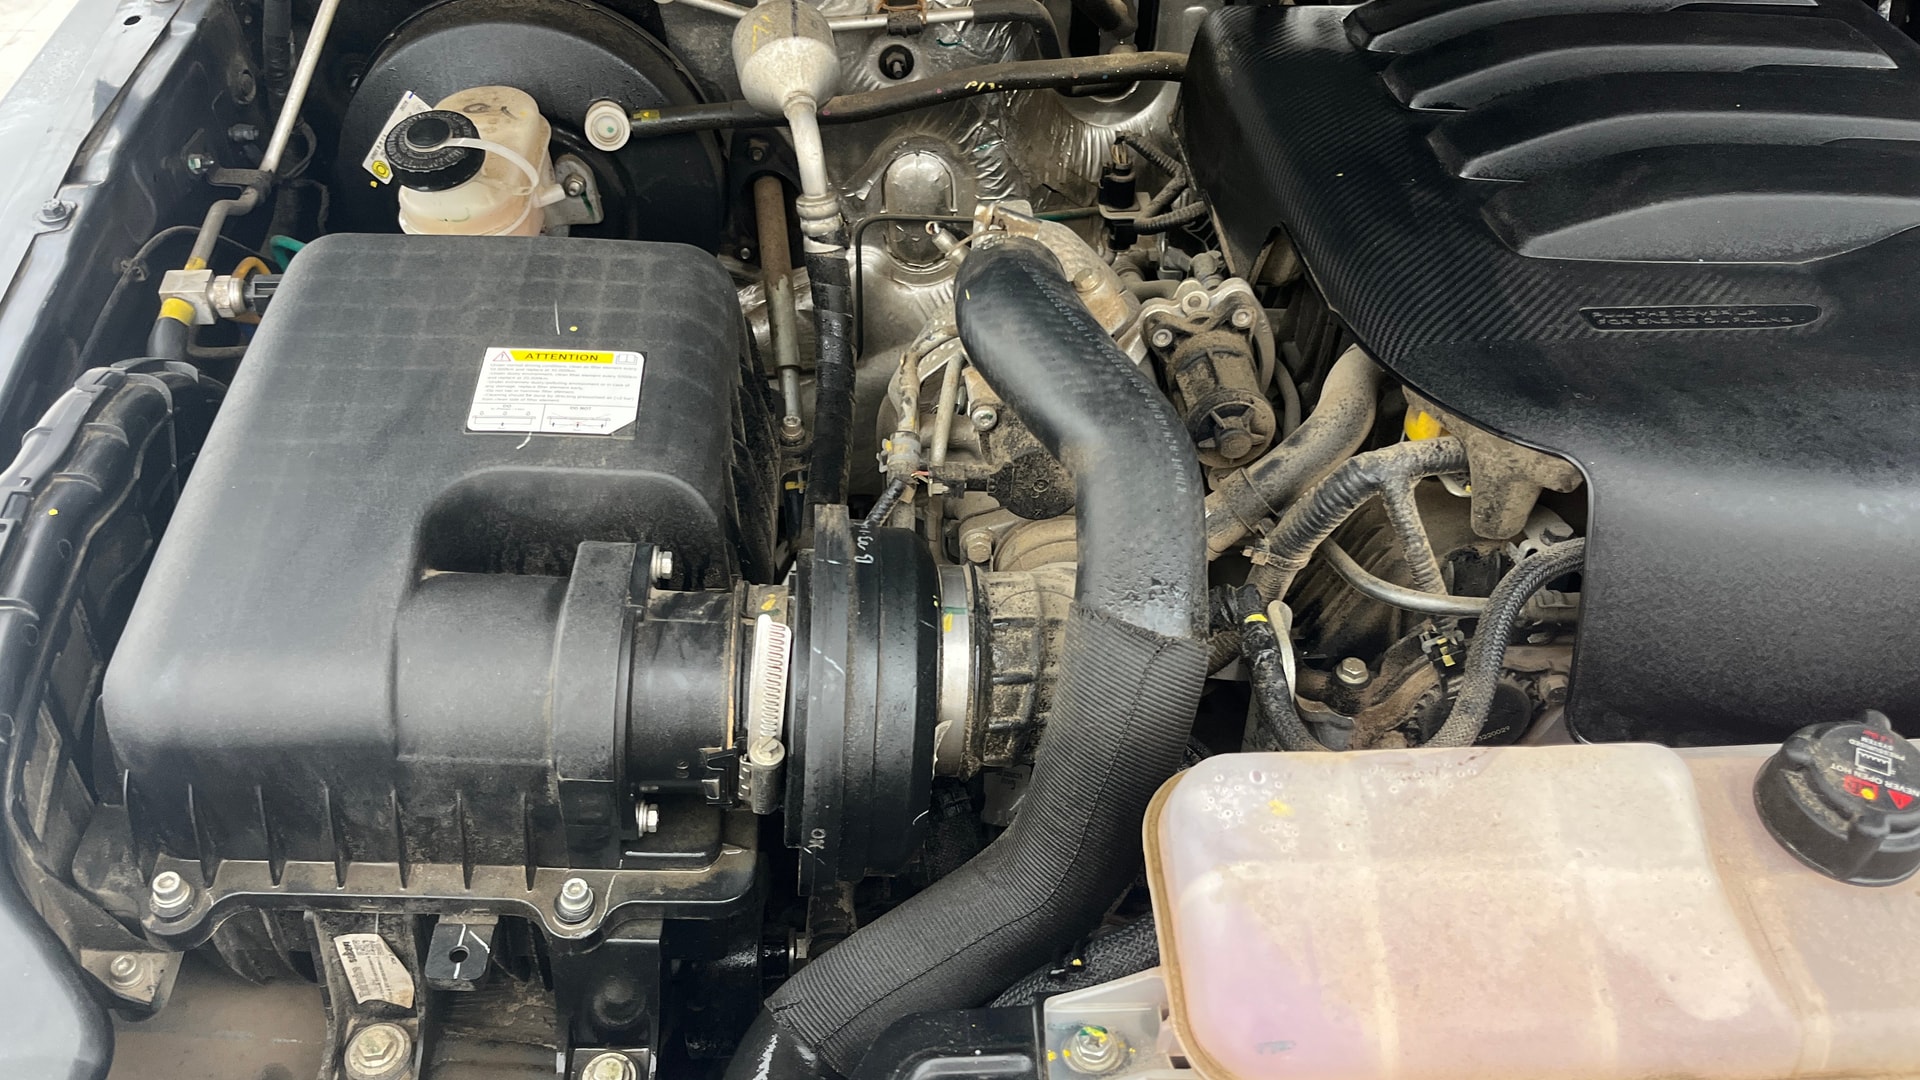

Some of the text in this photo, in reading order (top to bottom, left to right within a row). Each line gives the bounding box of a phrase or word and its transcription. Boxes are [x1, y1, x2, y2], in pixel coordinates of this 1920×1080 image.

[524, 352, 599, 362] ATTENTION
[1829, 763, 1853, 775] HOT
[1853, 770, 1883, 785] OPEN
[1883, 780, 1920, 798] NEVER
